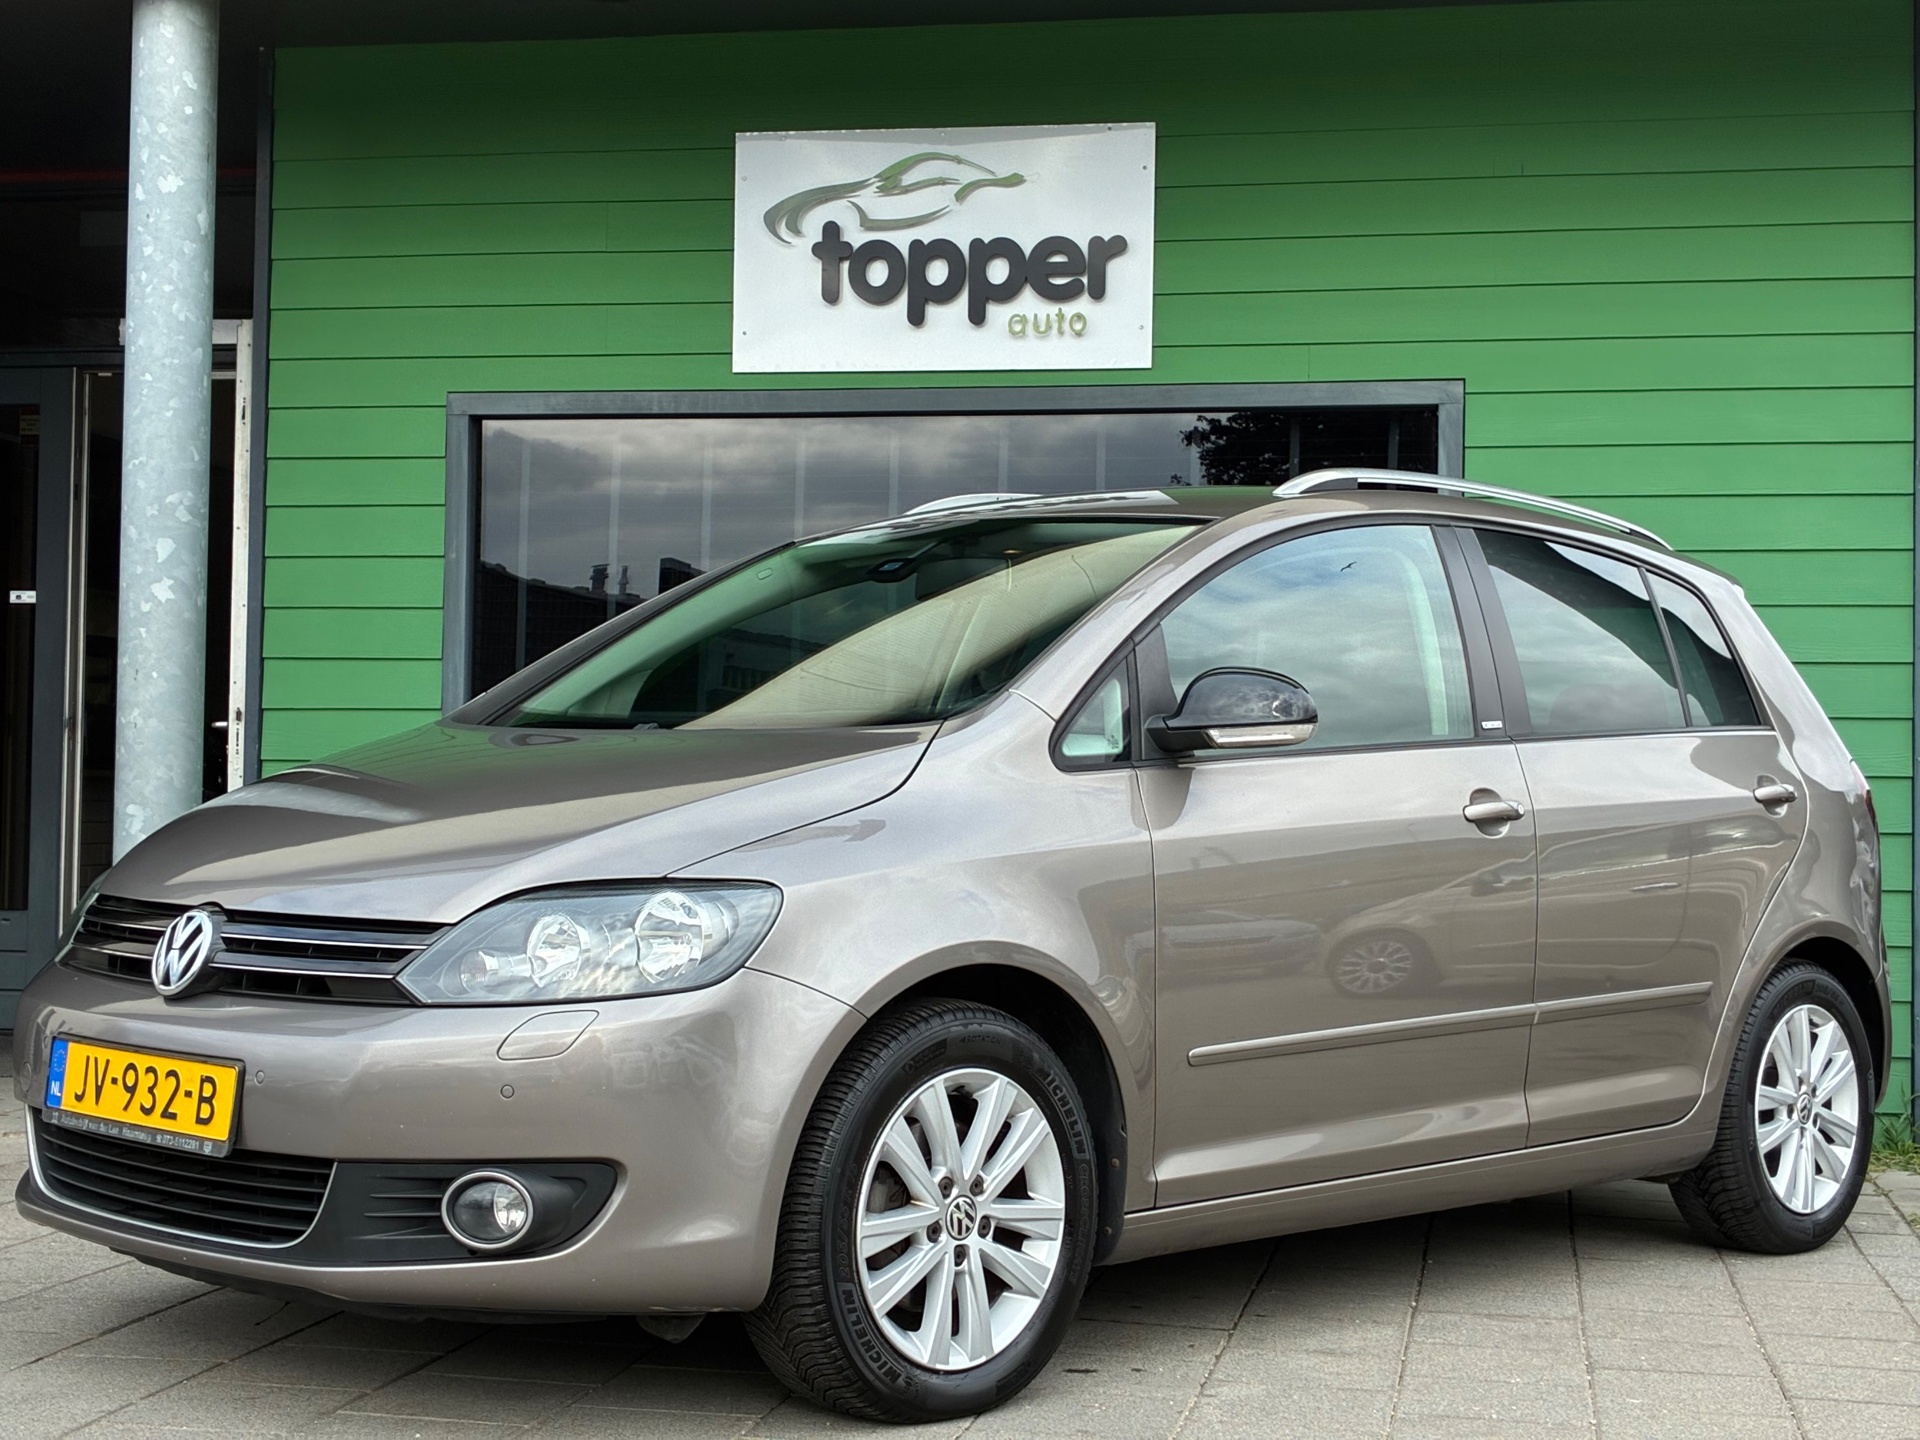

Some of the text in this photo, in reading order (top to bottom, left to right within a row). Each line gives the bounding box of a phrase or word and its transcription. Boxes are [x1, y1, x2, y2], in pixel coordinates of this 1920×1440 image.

[811, 220, 1129, 327] topper
[1008, 307, 1088, 337] auto
[50, 1080, 62, 1097] NL
[74, 1055, 218, 1126] JV-932-B
[1033, 1066, 1088, 1157] MICHELIN
[841, 1288, 904, 1383] MICHELIN
